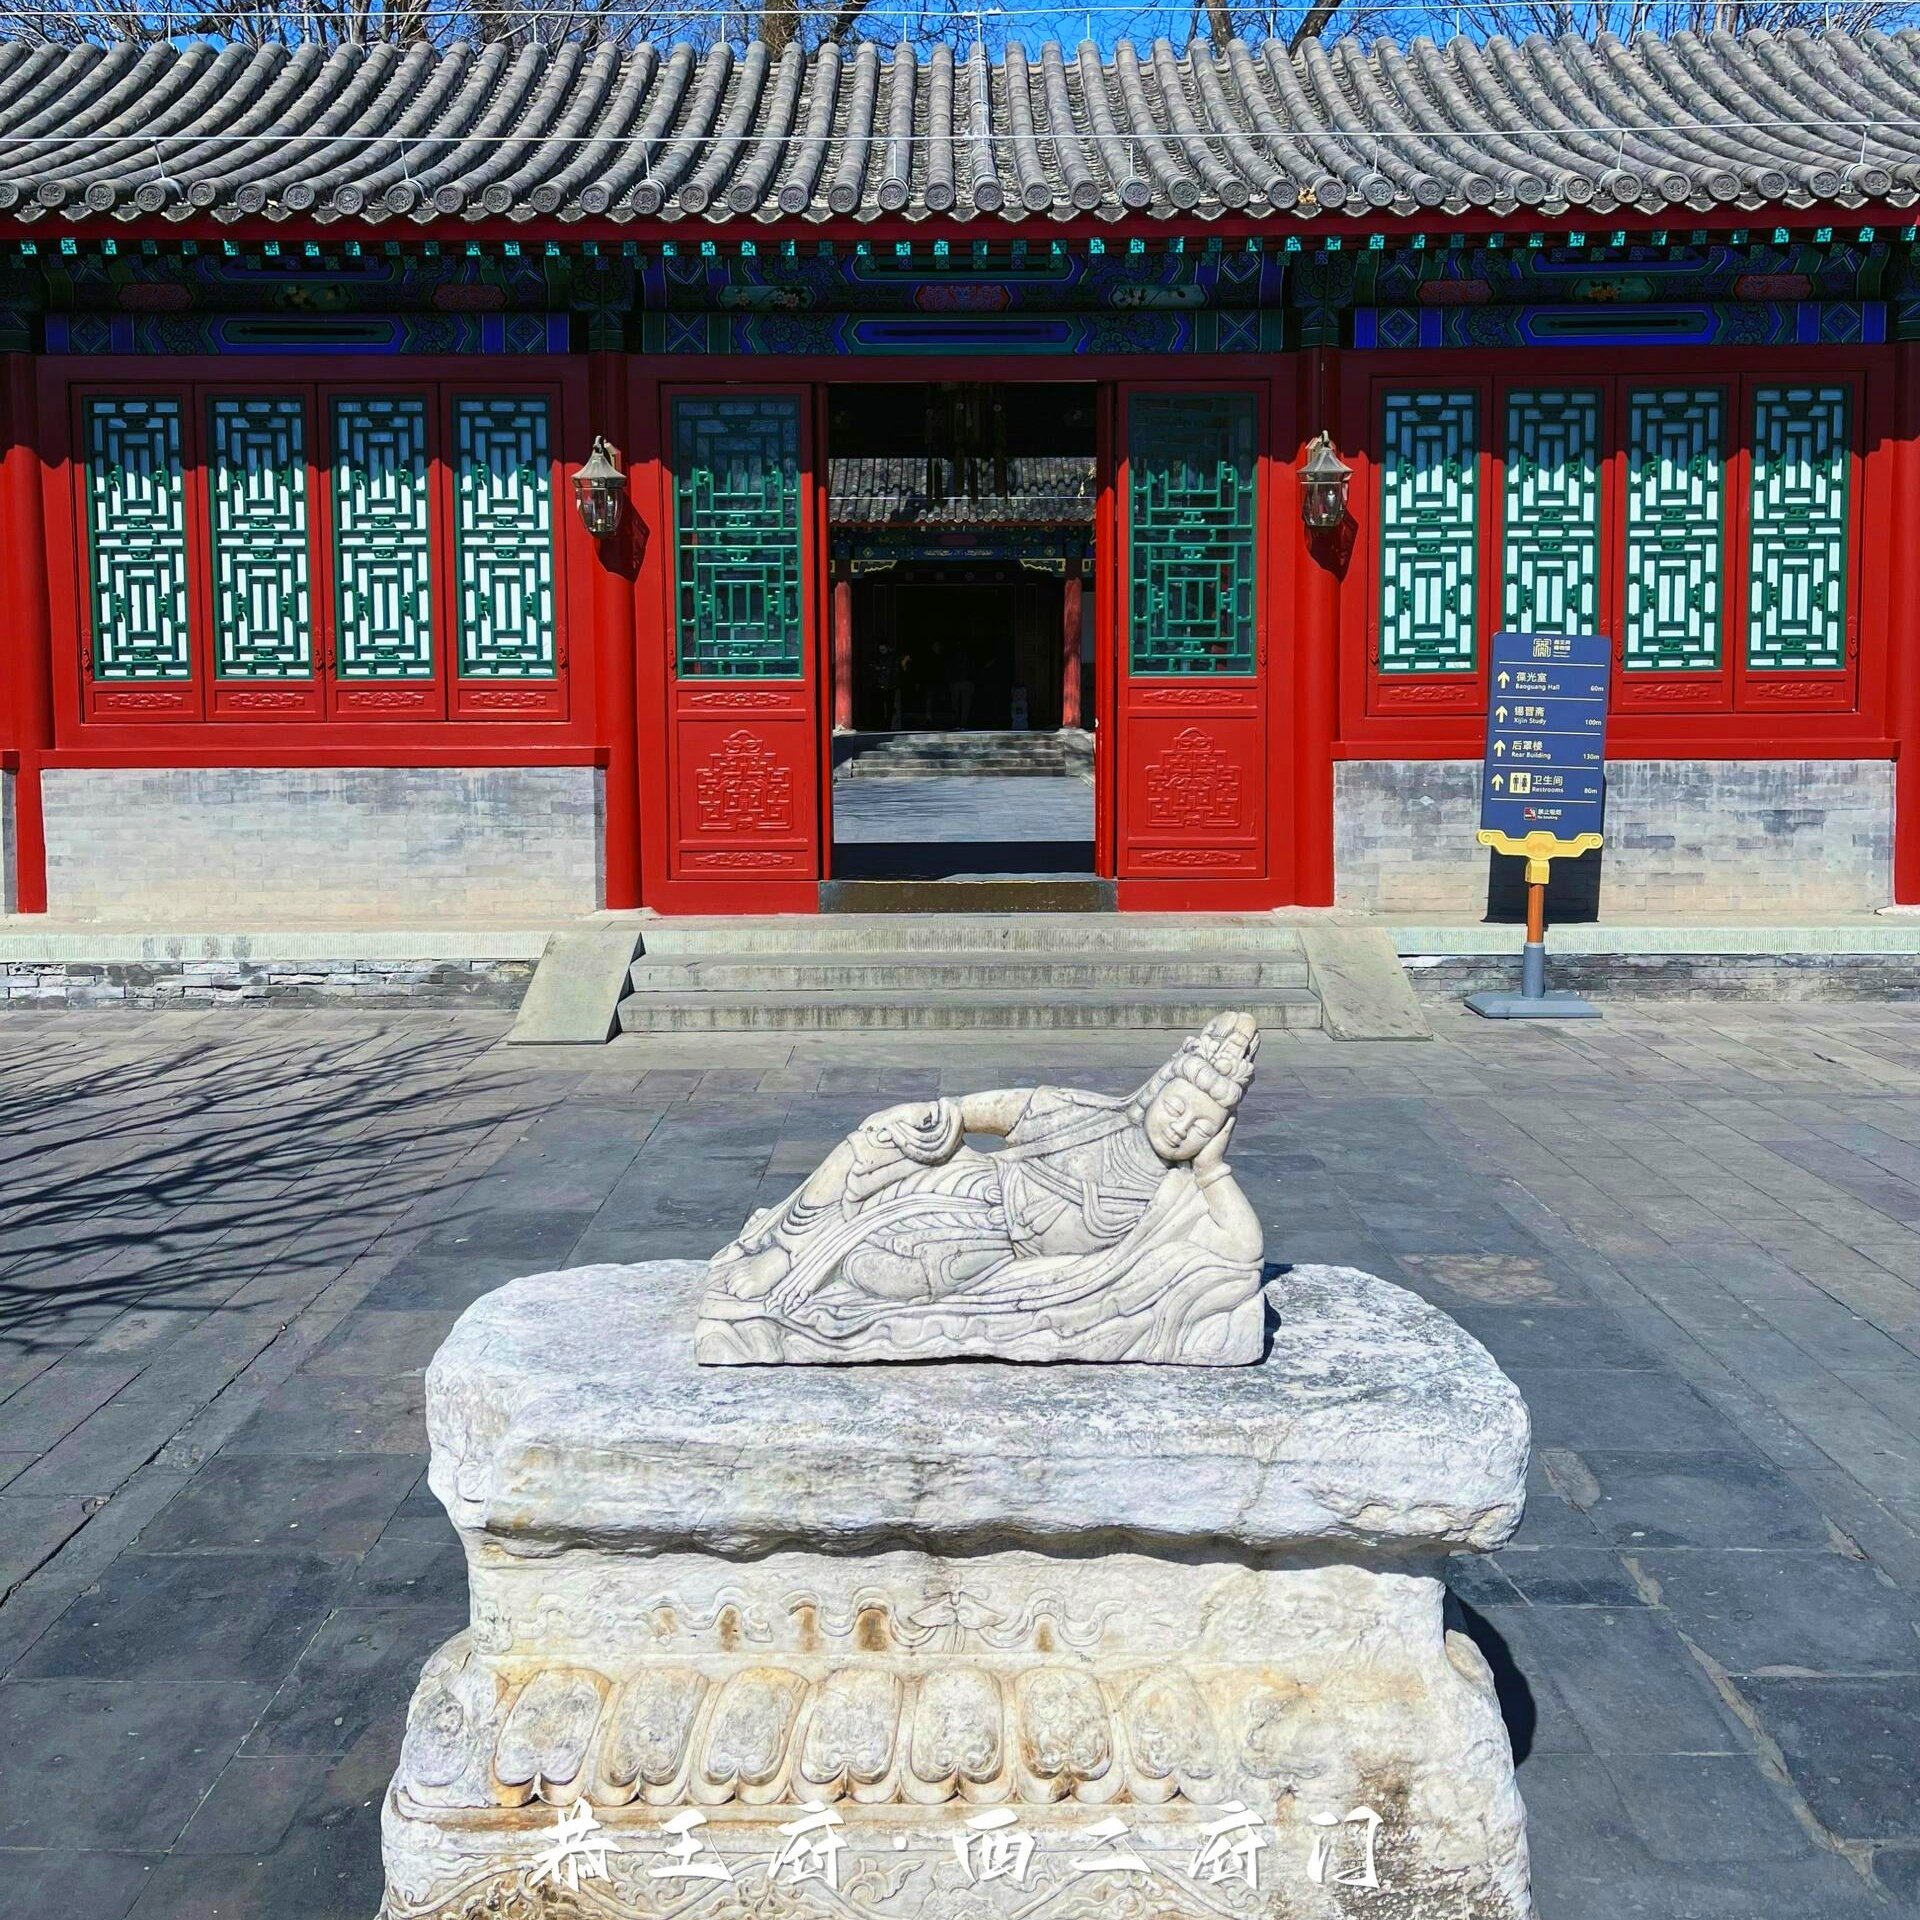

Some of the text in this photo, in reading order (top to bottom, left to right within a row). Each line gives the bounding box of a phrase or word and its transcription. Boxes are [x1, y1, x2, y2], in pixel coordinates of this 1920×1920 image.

[1515, 683, 1546, 691] Baoguang
[1513, 717, 1528, 725] Xijin
[1511, 740, 1543, 751] 后罩楼
[1526, 752, 1551, 760] Building
[1532, 775, 1563, 786] 卫生间
